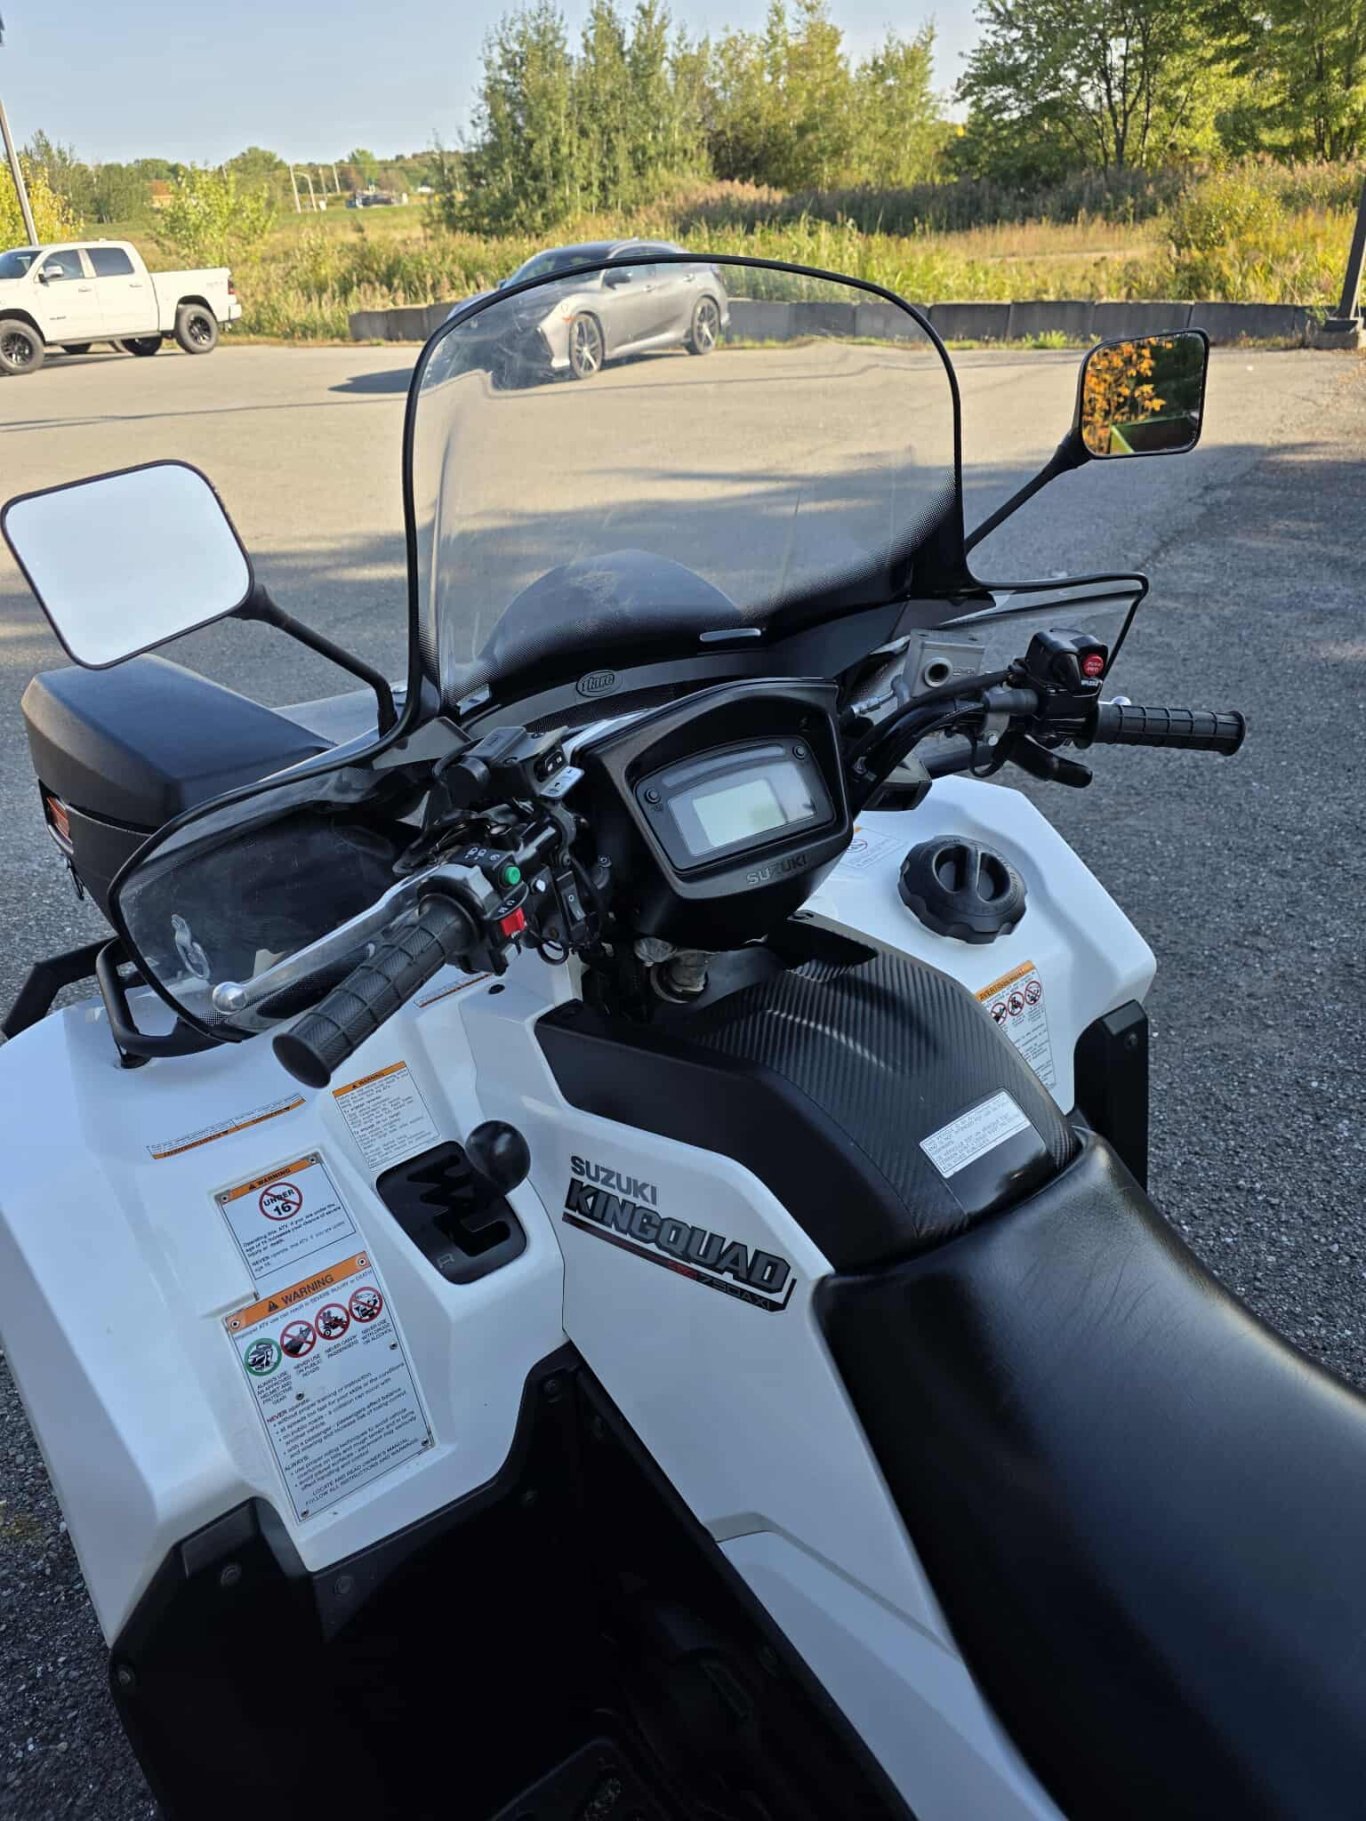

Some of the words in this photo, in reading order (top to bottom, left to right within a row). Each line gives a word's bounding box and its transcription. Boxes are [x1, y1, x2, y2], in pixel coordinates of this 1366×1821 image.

[746, 854, 807, 885] SUZUKI
[570, 1155, 658, 1206] SUZUKI
[263, 1188, 294, 1206] UNDER
[272, 1200, 292, 1216] 16
[564, 1177, 792, 1294] KINGQUAD
[280, 1273, 334, 1305] WARNING
